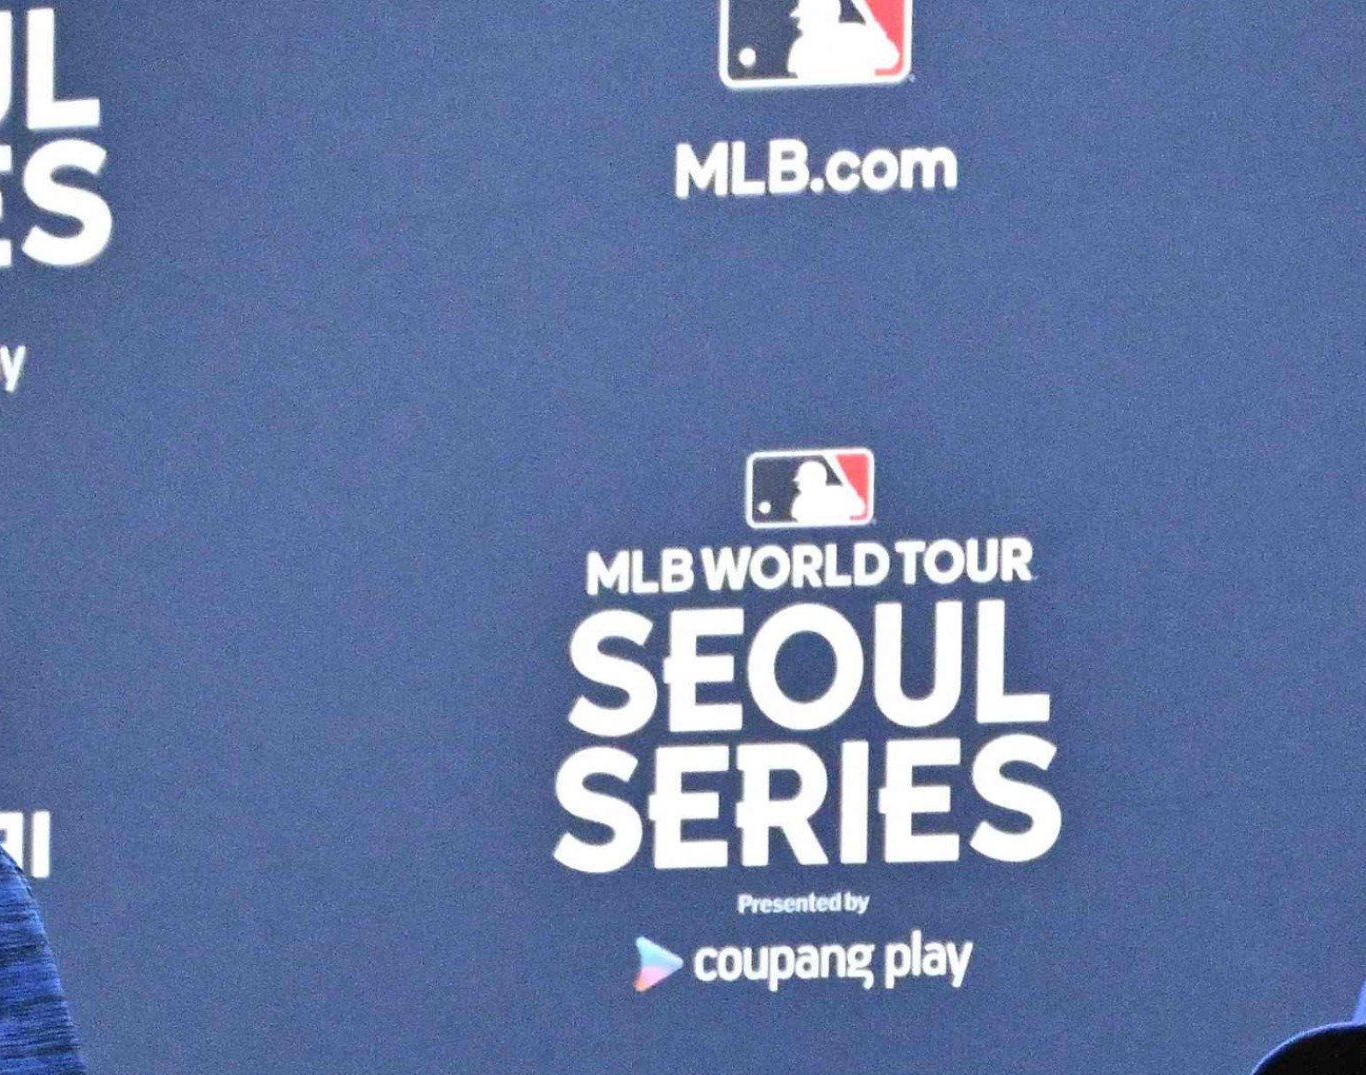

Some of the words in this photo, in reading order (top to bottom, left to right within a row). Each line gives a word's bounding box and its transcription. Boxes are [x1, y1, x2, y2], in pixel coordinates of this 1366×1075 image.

[675, 138, 957, 199] MLB.com
[586, 547, 694, 596] MLB
[698, 541, 890, 591] WORLD
[894, 536, 1034, 584] TOUR
[568, 599, 1050, 737] SEOUL
[553, 733, 1063, 874] SERIES
[737, 892, 841, 916] Presented
[842, 892, 870, 914] by
[694, 941, 876, 991] coupang
[885, 929, 973, 989] play
